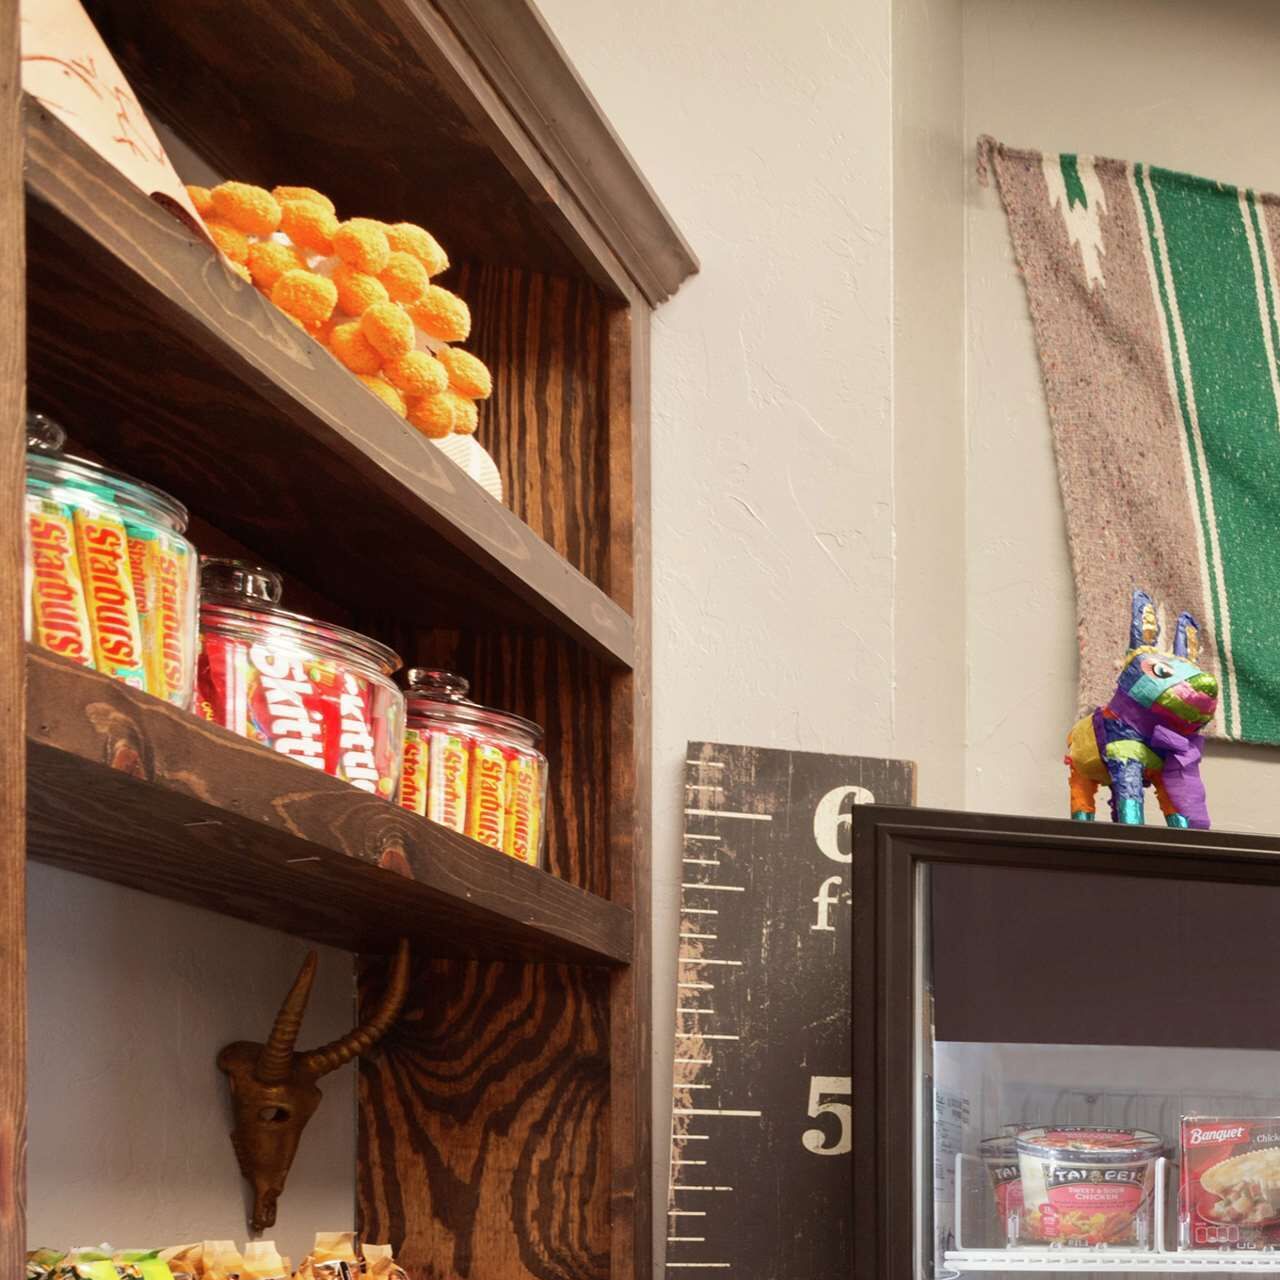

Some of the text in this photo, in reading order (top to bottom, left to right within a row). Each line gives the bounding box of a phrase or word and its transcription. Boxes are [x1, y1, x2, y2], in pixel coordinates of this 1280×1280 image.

[84, 523, 140, 668] Starburst
[812, 785, 864, 864] 6
[801, 1075, 854, 1156] 5
[1190, 1126, 1246, 1145] Banquet
[1056, 1166, 1088, 1182] TAI
[1074, 1193, 1119, 1202] CHICKEN
